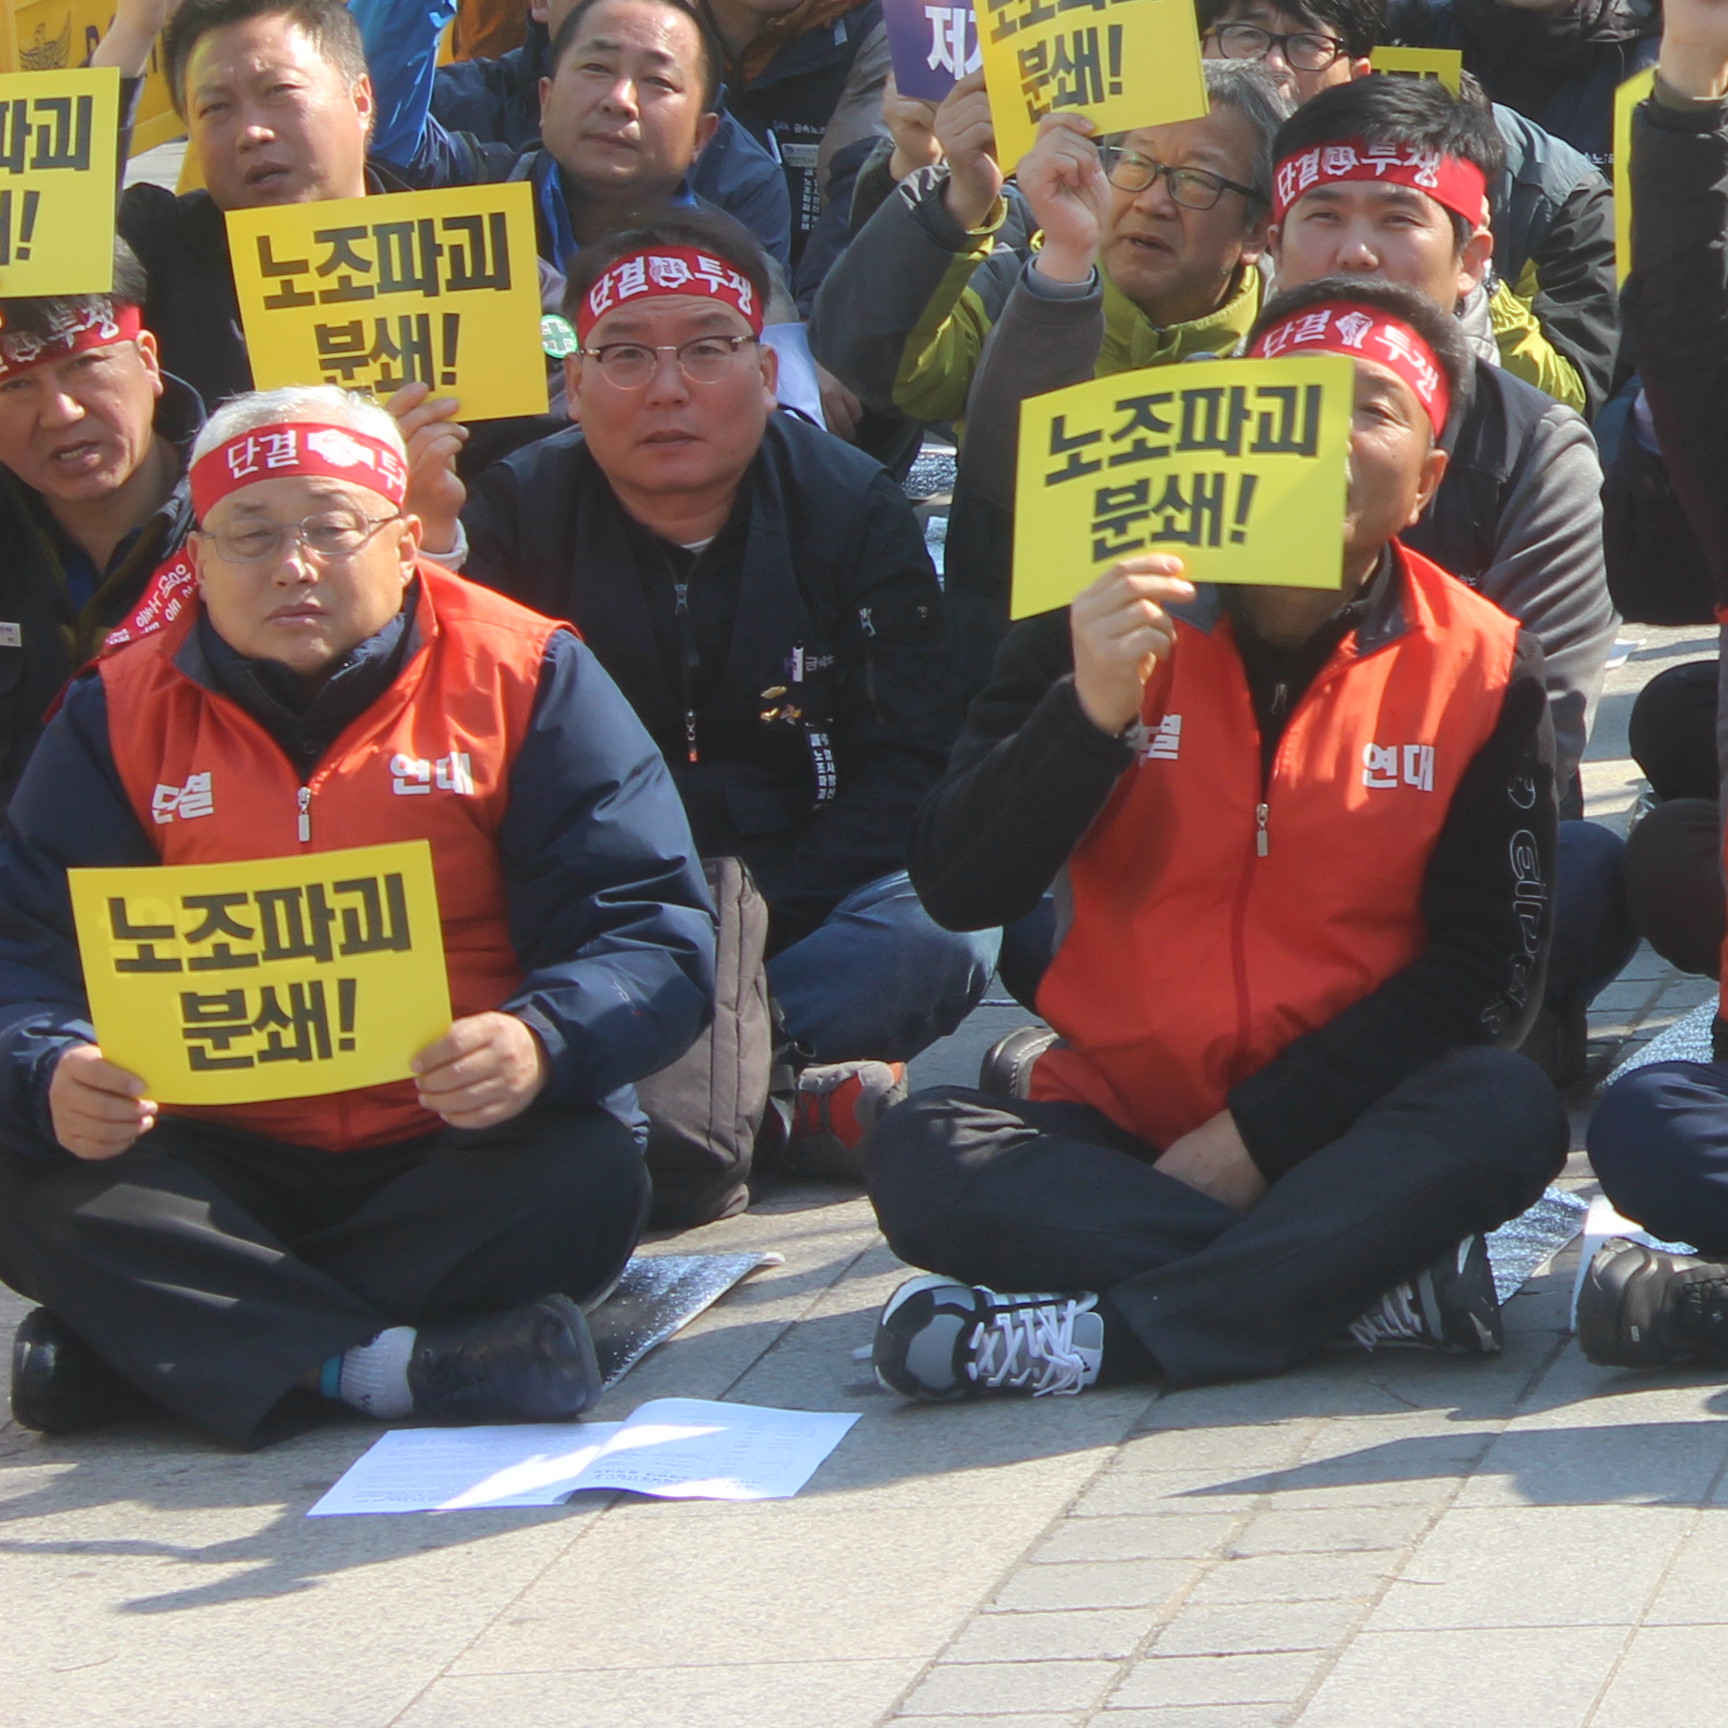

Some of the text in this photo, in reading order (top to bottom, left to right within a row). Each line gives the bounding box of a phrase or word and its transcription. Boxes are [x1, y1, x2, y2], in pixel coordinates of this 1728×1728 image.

[256, 210, 513, 314] 노조파괴
[584, 251, 756, 319] 단결 투쟁
[312, 312, 460, 396] 분쇄!
[1259, 308, 1442, 403] 단결 투쟁
[226, 430, 300, 480] 단결
[1043, 383, 1321, 489] 노조파괴
[1089, 469, 1257, 560] 분쇄!
[389, 749, 476, 801] 연대
[1361, 741, 1435, 795] 연대
[105, 870, 413, 975] 노조파괴
[179, 976, 360, 1075] 분쇄!
